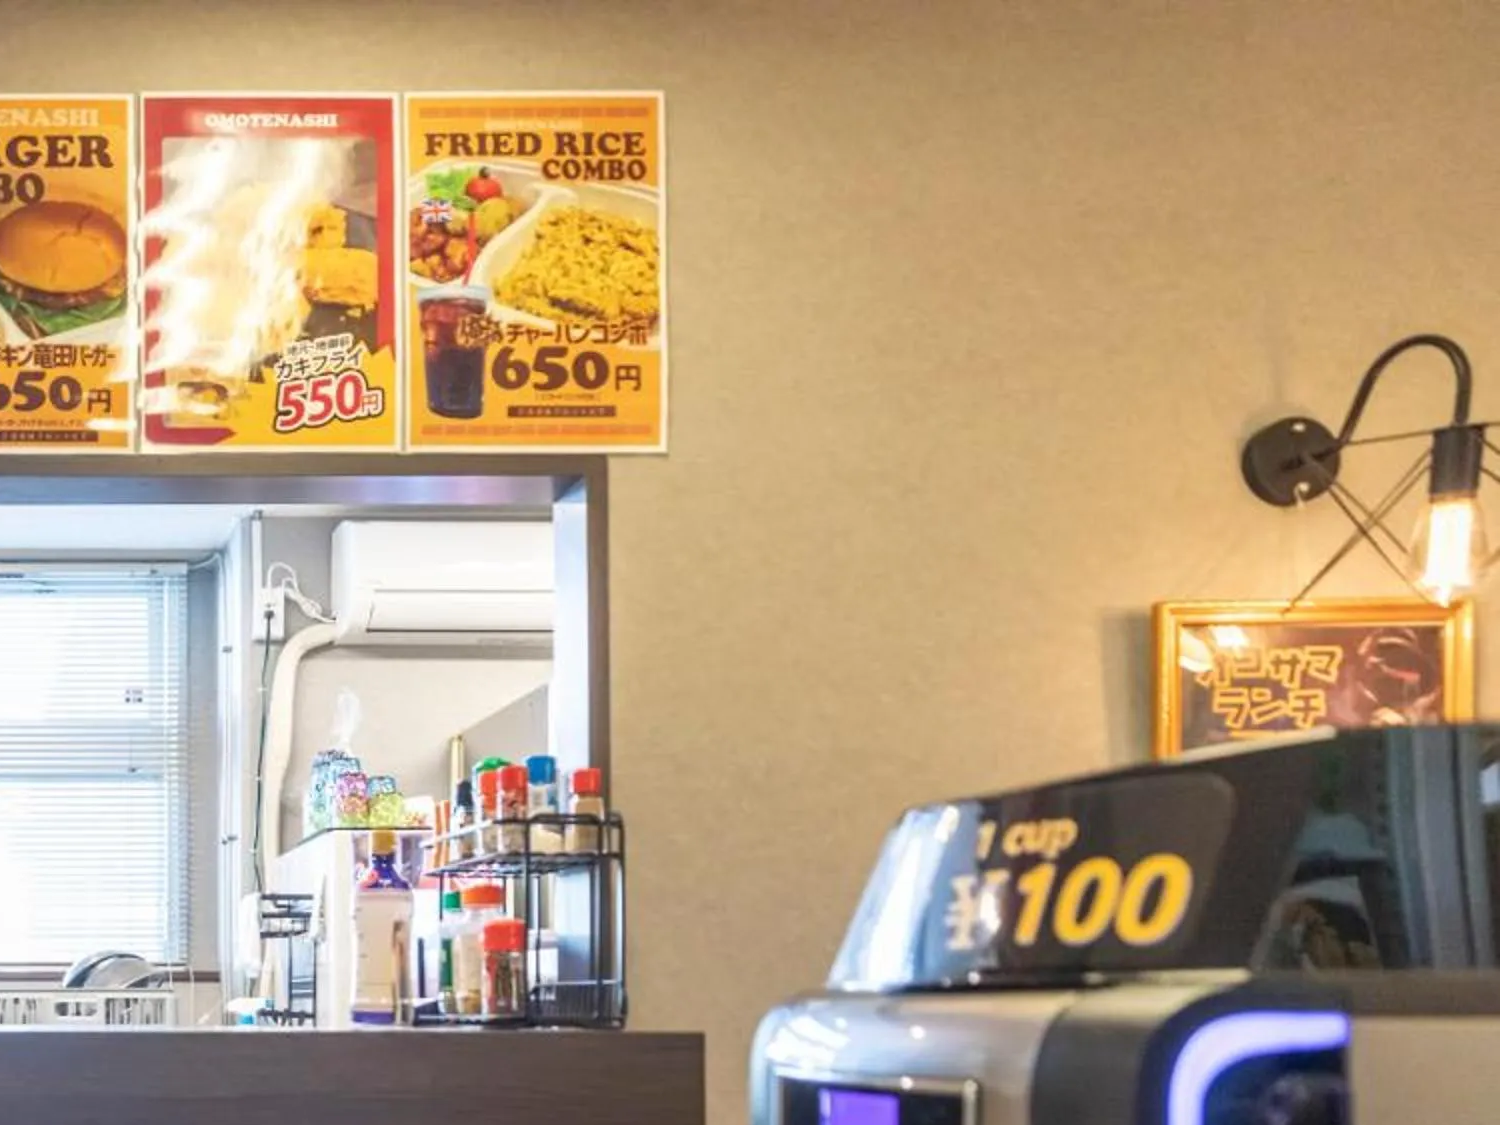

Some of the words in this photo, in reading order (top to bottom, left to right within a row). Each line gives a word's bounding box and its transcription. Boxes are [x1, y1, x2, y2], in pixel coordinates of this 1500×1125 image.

[204, 112, 339, 128] OMOTENASHI
[424, 131, 542, 156] FRIED
[554, 131, 647, 156] RICE
[541, 159, 647, 181] COMBO
[276, 348, 362, 379] カキフライ
[490, 346, 642, 391] 650円
[279, 374, 381, 427] 550円
[1213, 687, 1328, 730] ランチ
[1002, 817, 1079, 858] cup
[945, 853, 1194, 949] ¥100
